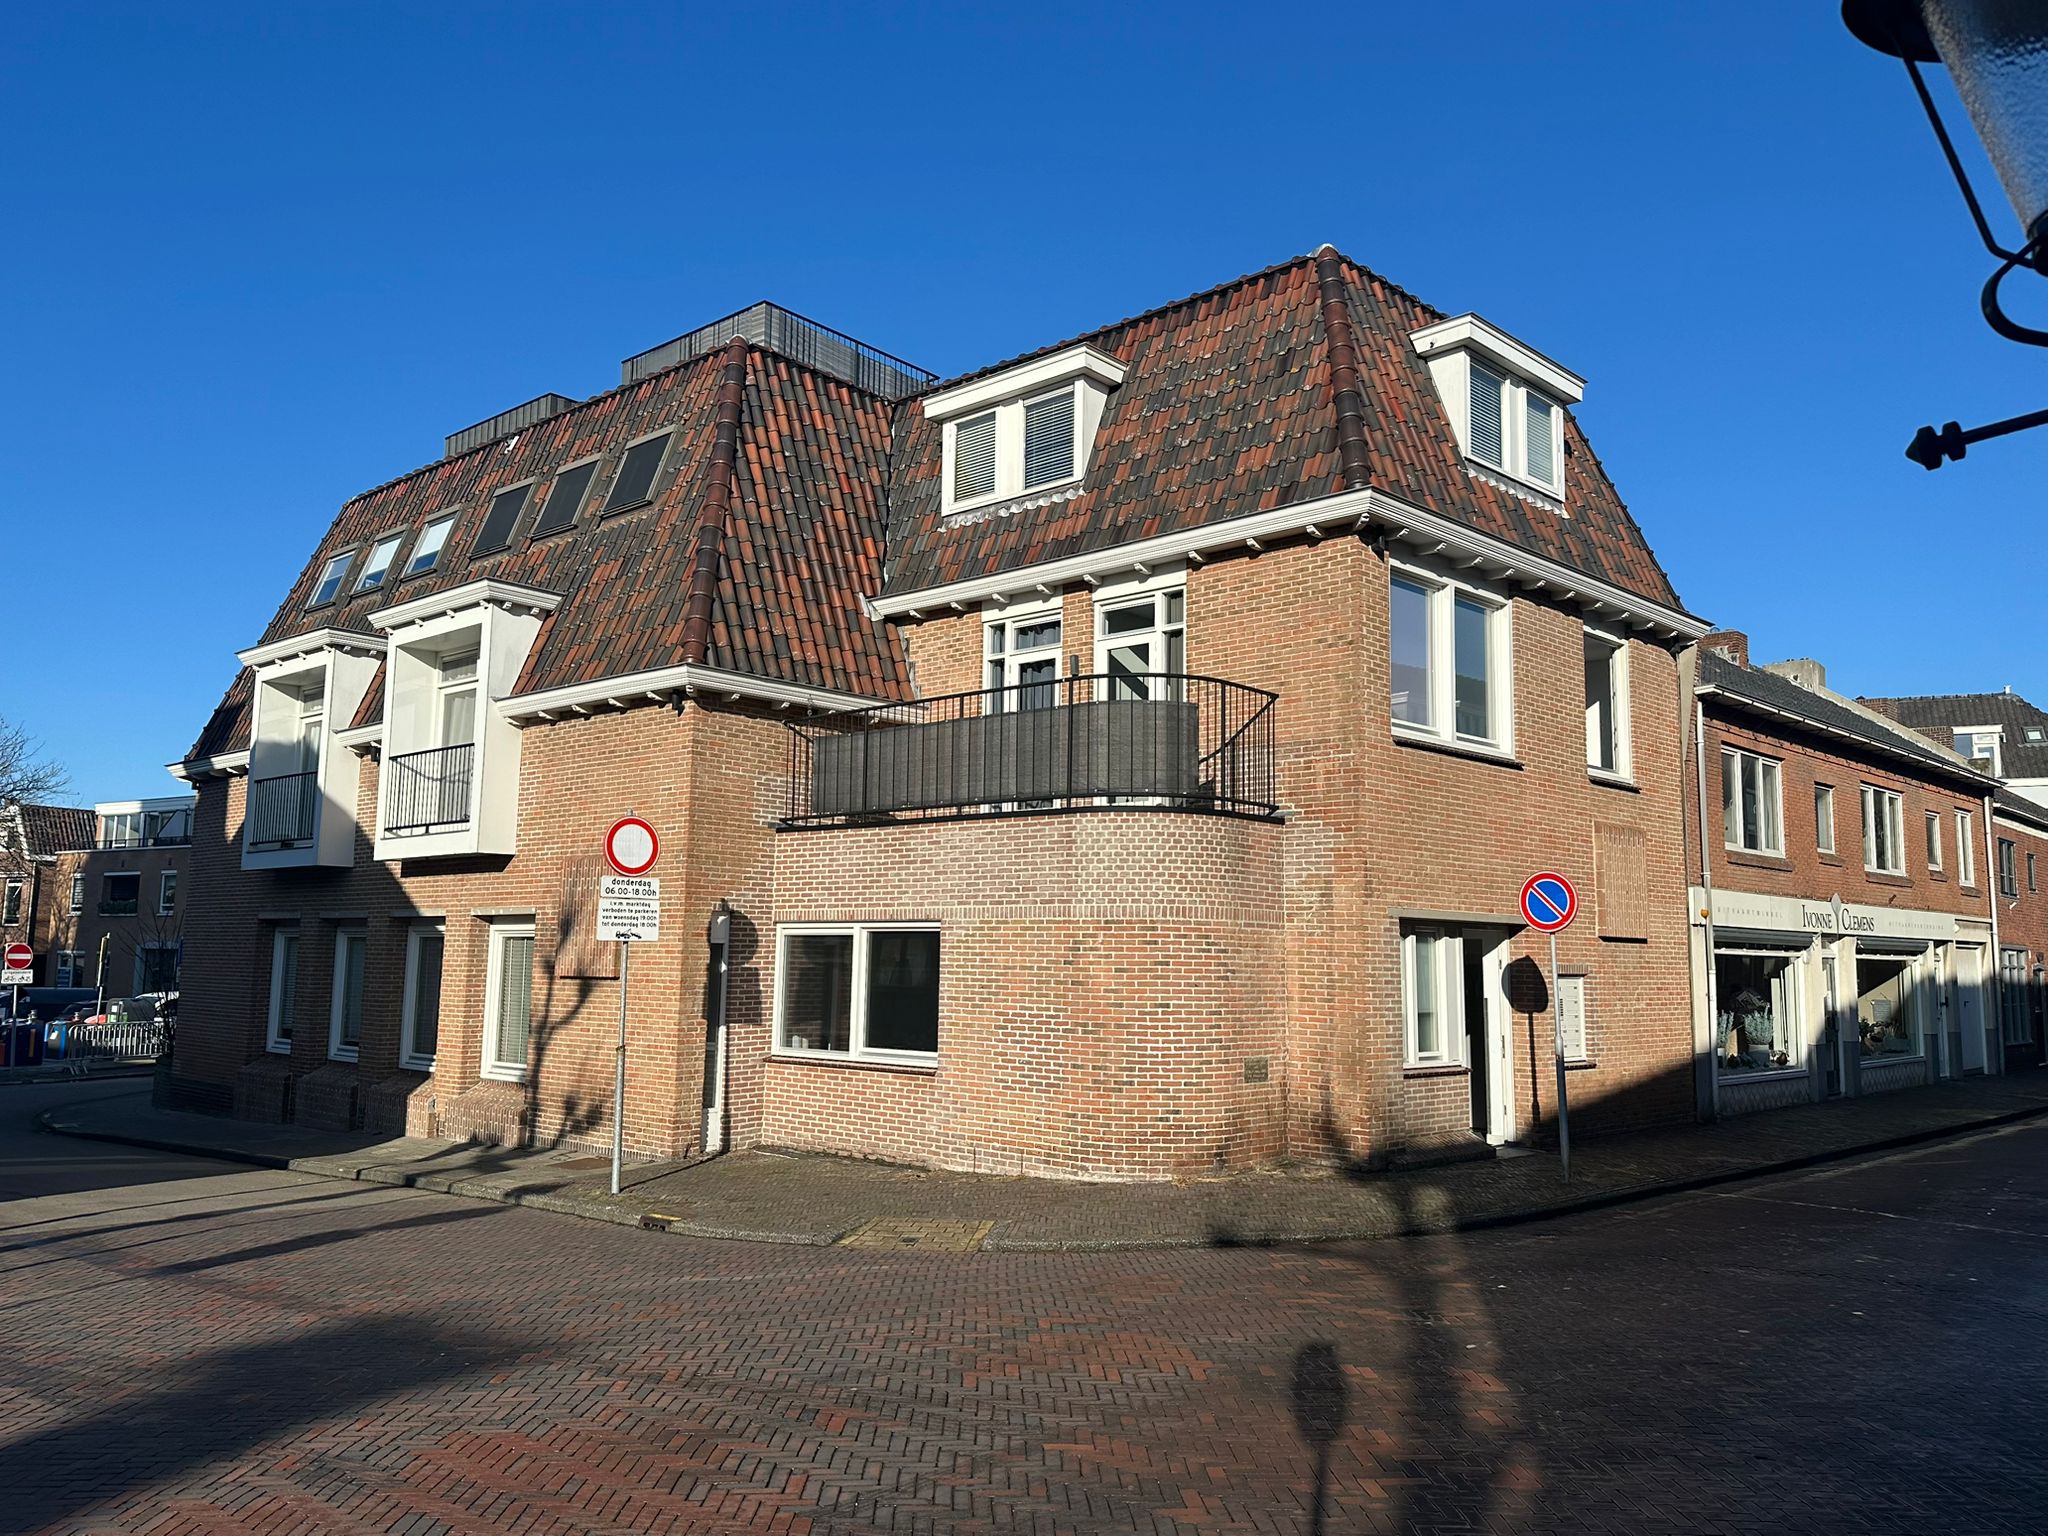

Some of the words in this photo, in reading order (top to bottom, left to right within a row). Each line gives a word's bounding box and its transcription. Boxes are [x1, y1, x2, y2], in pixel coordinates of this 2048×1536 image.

[611, 878, 651, 888] donderdag
[605, 887, 657, 896] 06.00-18.00h
[1802, 904, 1832, 930] IVONNE
[1841, 908, 1875, 932] CLEMENS
